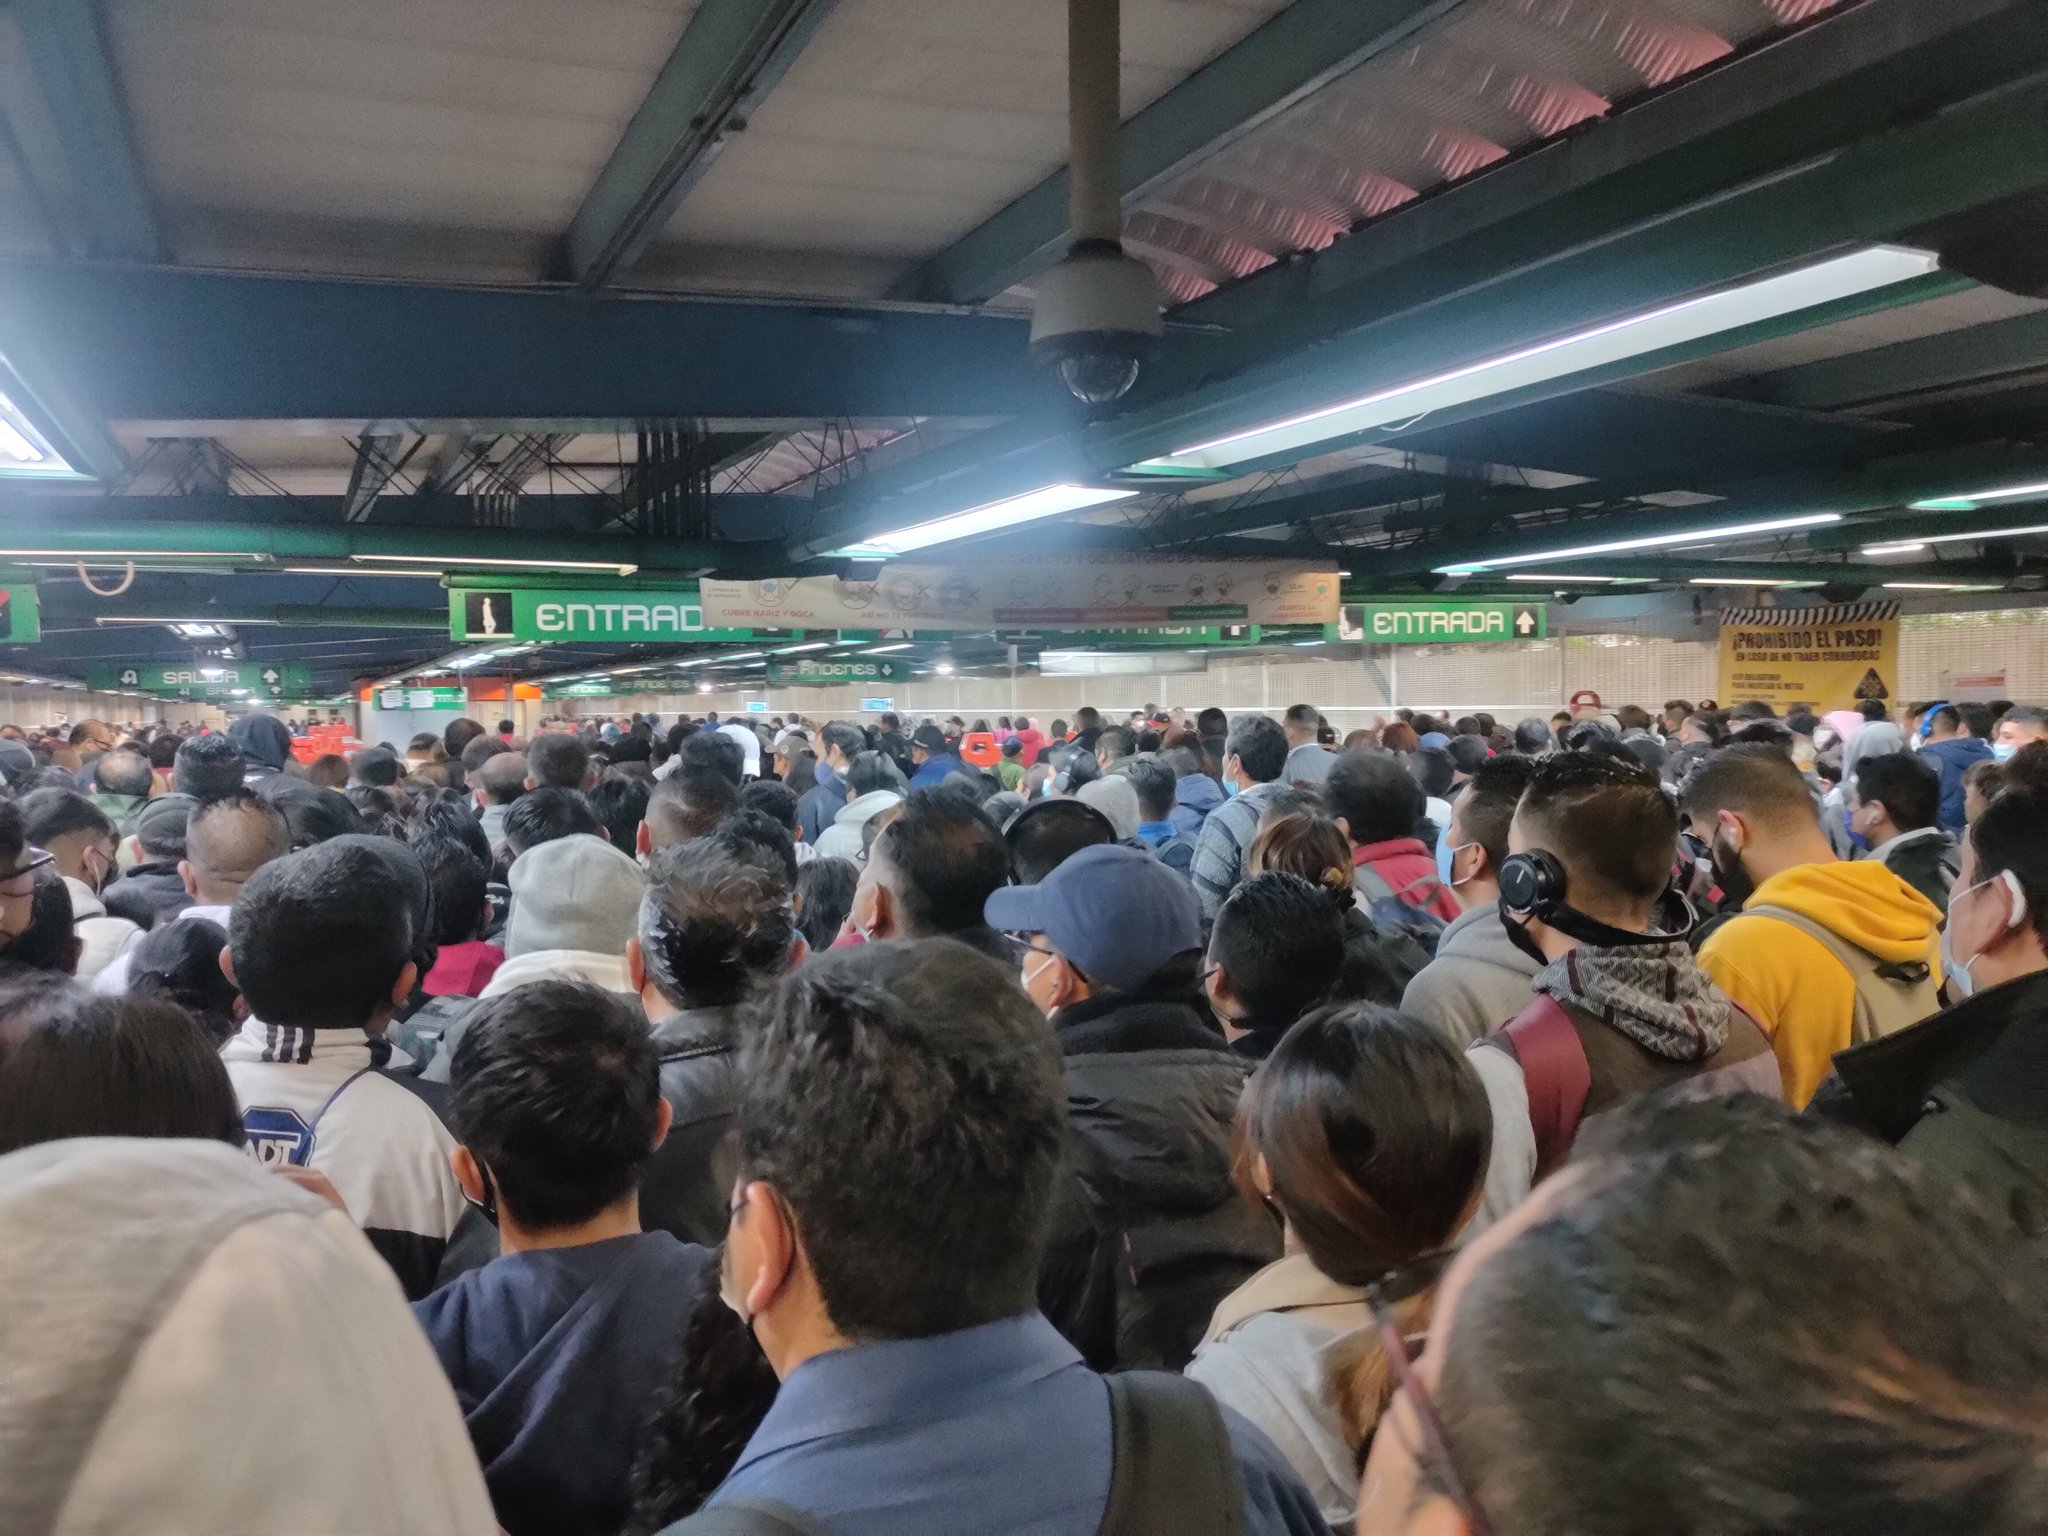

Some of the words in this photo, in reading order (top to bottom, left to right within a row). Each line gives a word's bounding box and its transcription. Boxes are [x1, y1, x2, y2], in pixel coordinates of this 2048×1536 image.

[536, 603, 735, 631] ENTRAD
[721, 609, 752, 617] CUBRE
[753, 609, 780, 617] NARIZ
[791, 609, 815, 617] BOCA
[1373, 611, 1505, 635] ENTRADA
[1733, 630, 1812, 650] ¡PROHIBIDO
[1816, 630, 1832, 648] EL
[1835, 628, 1882, 647] PASO!
[1736, 652, 1745, 661] EN
[1747, 652, 1768, 661] CASO
[1769, 652, 1779, 661] DE
[1781, 652, 1792, 661] NO
[799, 663, 877, 676] ANDENES
[207, 686, 255, 697] SALA
